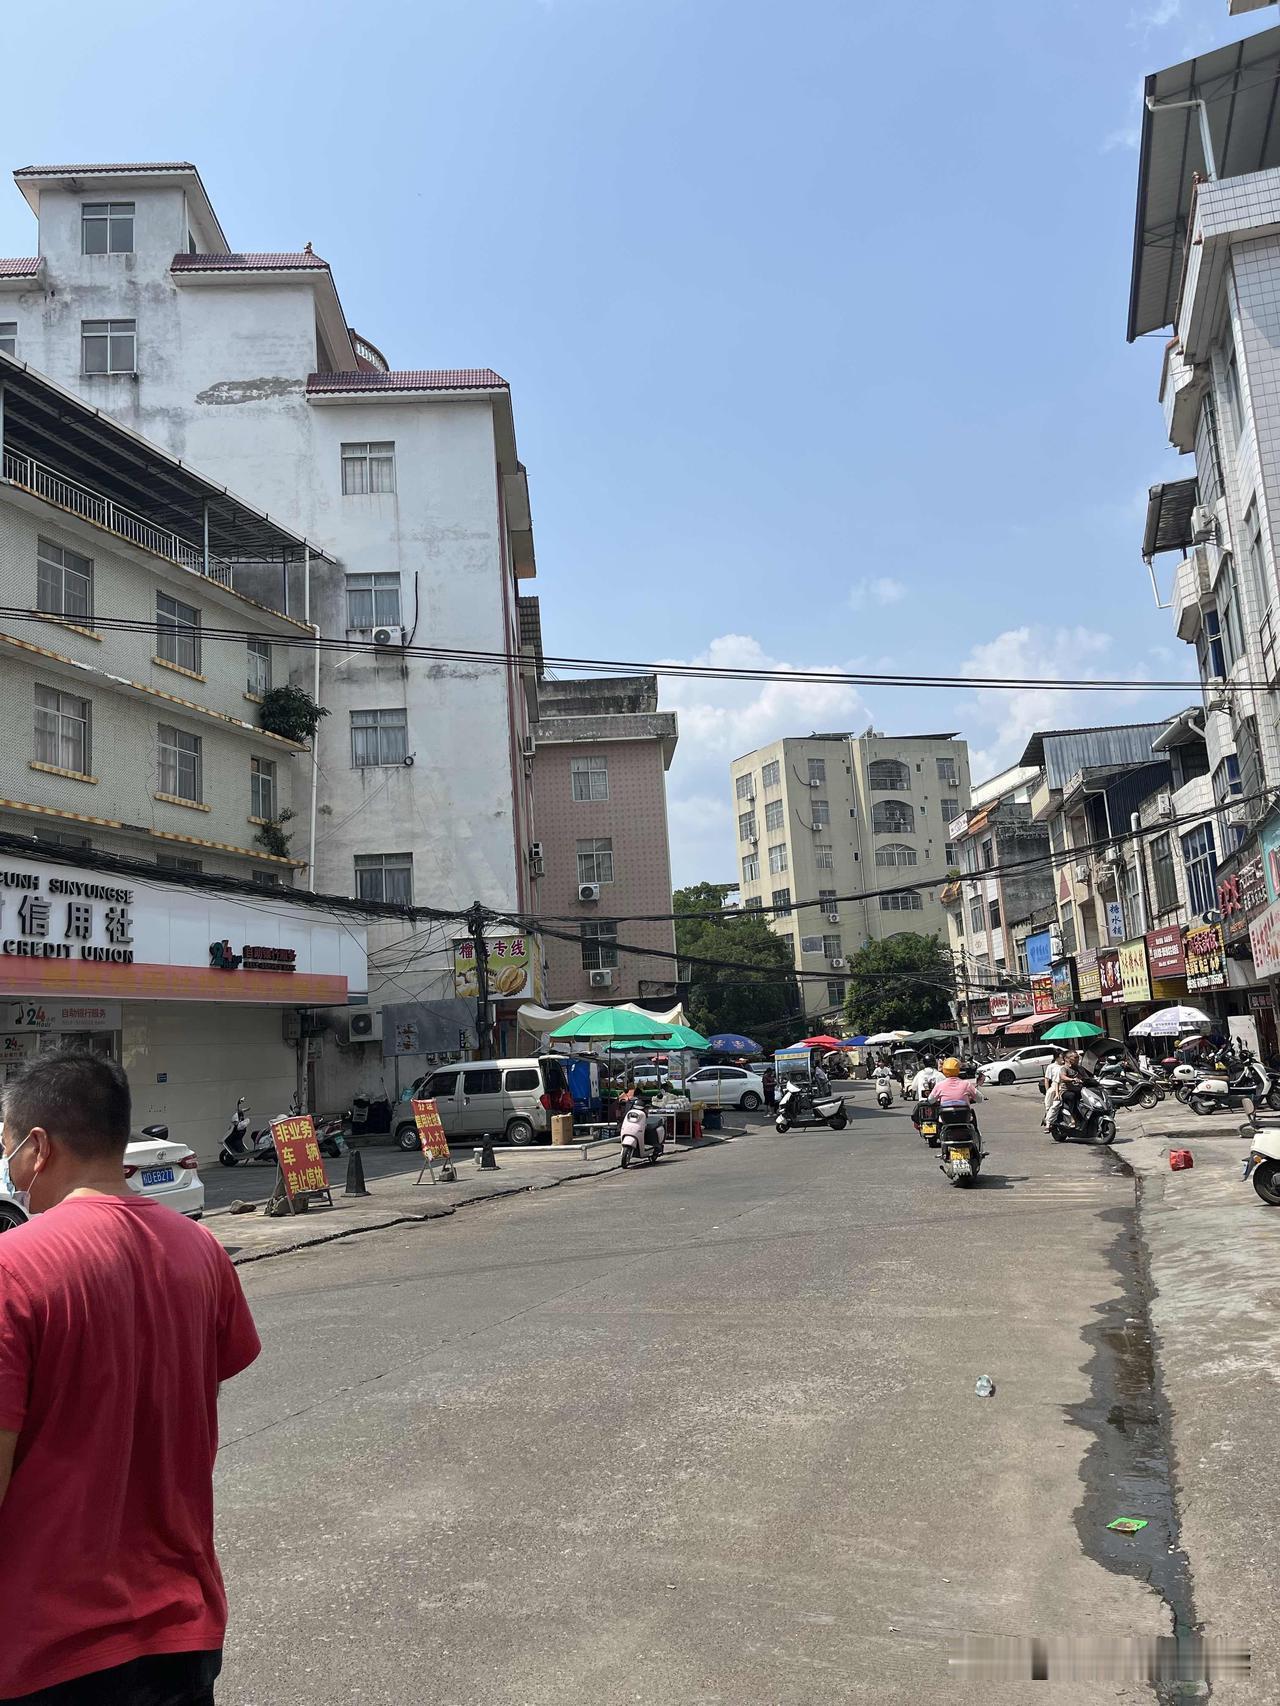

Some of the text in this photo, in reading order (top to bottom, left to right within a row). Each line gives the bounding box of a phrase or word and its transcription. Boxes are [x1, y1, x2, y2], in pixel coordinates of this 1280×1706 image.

[49, 878, 134, 904] SINYUNGSE
[0, 891, 134, 944] 信用社
[3, 939, 134, 963] CREDIT UNION
[26, 1006, 46, 1025] 24
[275, 1120, 313, 1143] 非业务
[281, 1146, 297, 1166] 车
[305, 1142, 319, 1162] 辆
[287, 1165, 326, 1195] 禁止停放
